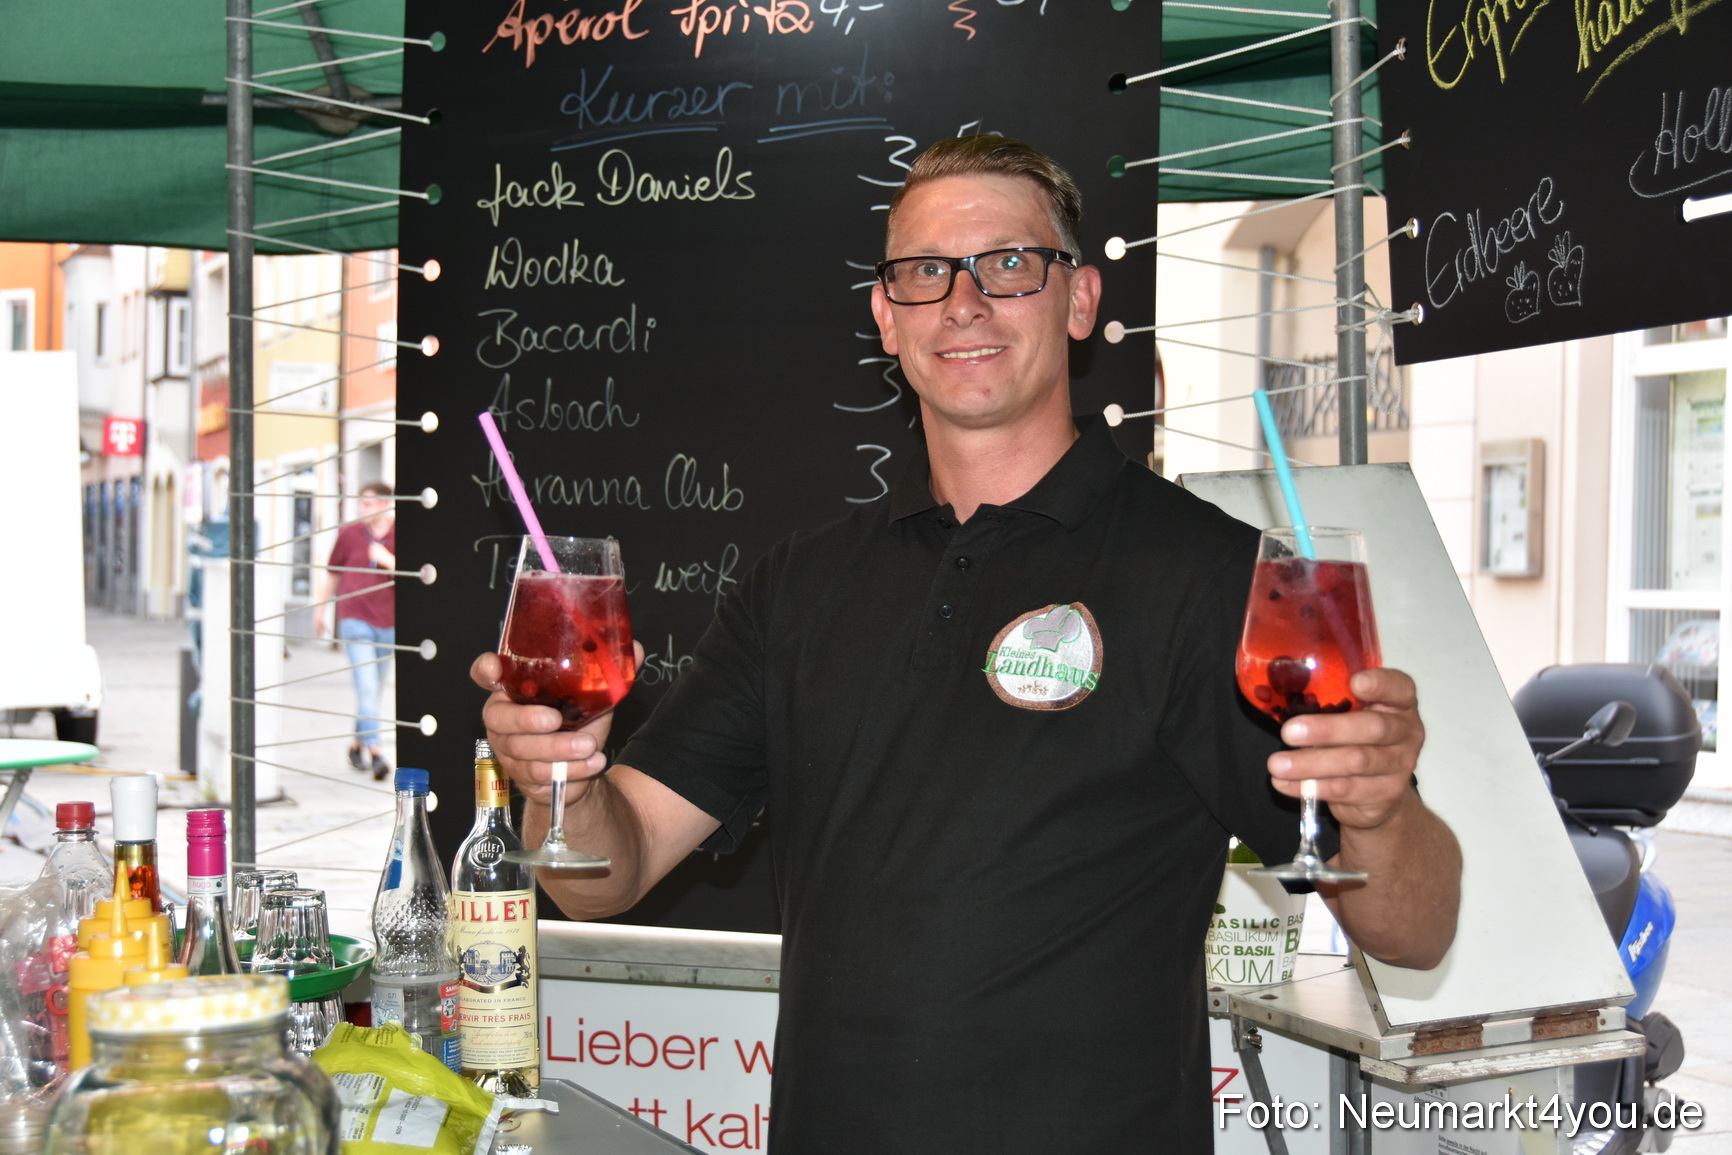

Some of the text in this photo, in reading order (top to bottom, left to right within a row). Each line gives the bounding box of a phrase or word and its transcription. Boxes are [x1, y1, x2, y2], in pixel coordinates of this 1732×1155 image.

[560, 64, 754, 130] Kurzer
[477, 146, 757, 226] Jack Daniels
[484, 236, 625, 290] Wodka
[1425, 176, 1563, 309] Erdbeere
[476, 302, 657, 368] Bacardi
[487, 372, 641, 433] Asbach
[665, 452, 745, 512] Club
[981, 650, 1101, 692] Landhaus
[999, 645, 1037, 660] Kleines
[1208, 931, 1280, 943] BASILIKUM
[1233, 945, 1276, 957] BASIL
[482, 1012, 506, 1023] TRÈS
[508, 1012, 532, 1022] FRAIS
[546, 1015, 719, 1071] Lieber
